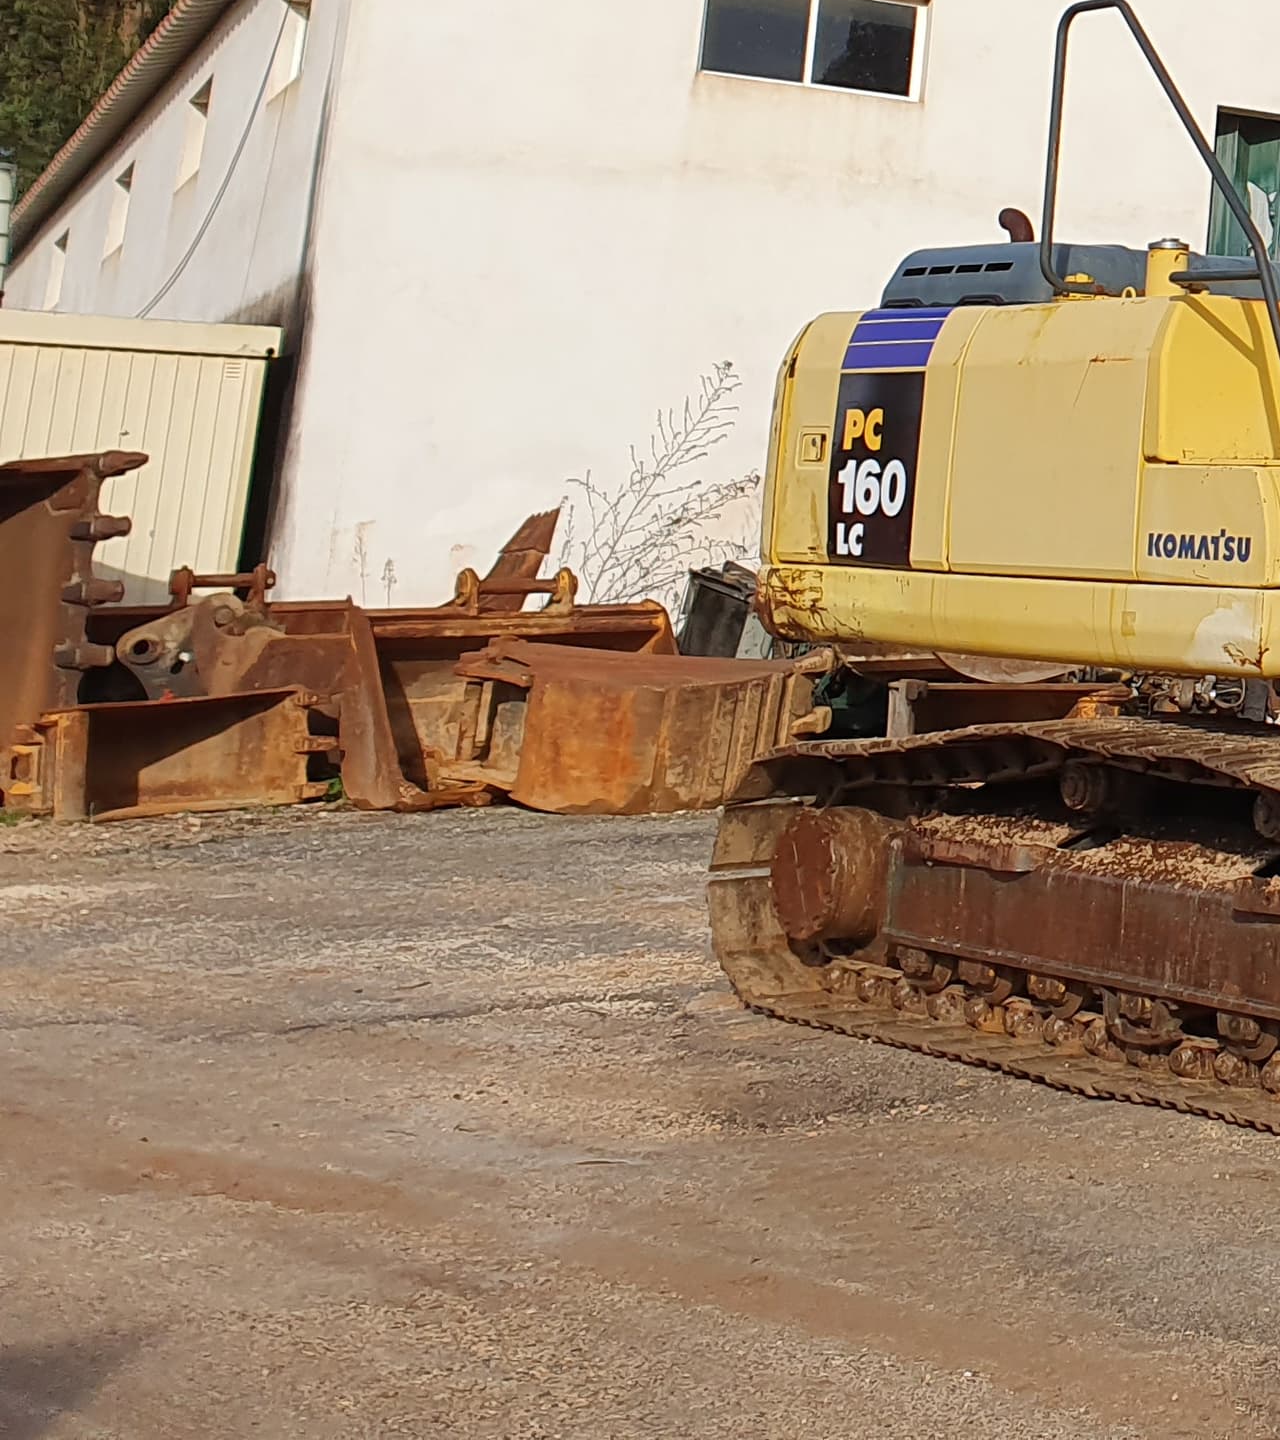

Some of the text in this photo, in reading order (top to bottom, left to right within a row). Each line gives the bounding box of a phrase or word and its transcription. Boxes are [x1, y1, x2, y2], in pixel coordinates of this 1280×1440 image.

[841, 407, 884, 452] PC
[836, 458, 907, 518] 160
[835, 521, 864, 557] LC
[1146, 527, 1252, 563] KOMATSU
